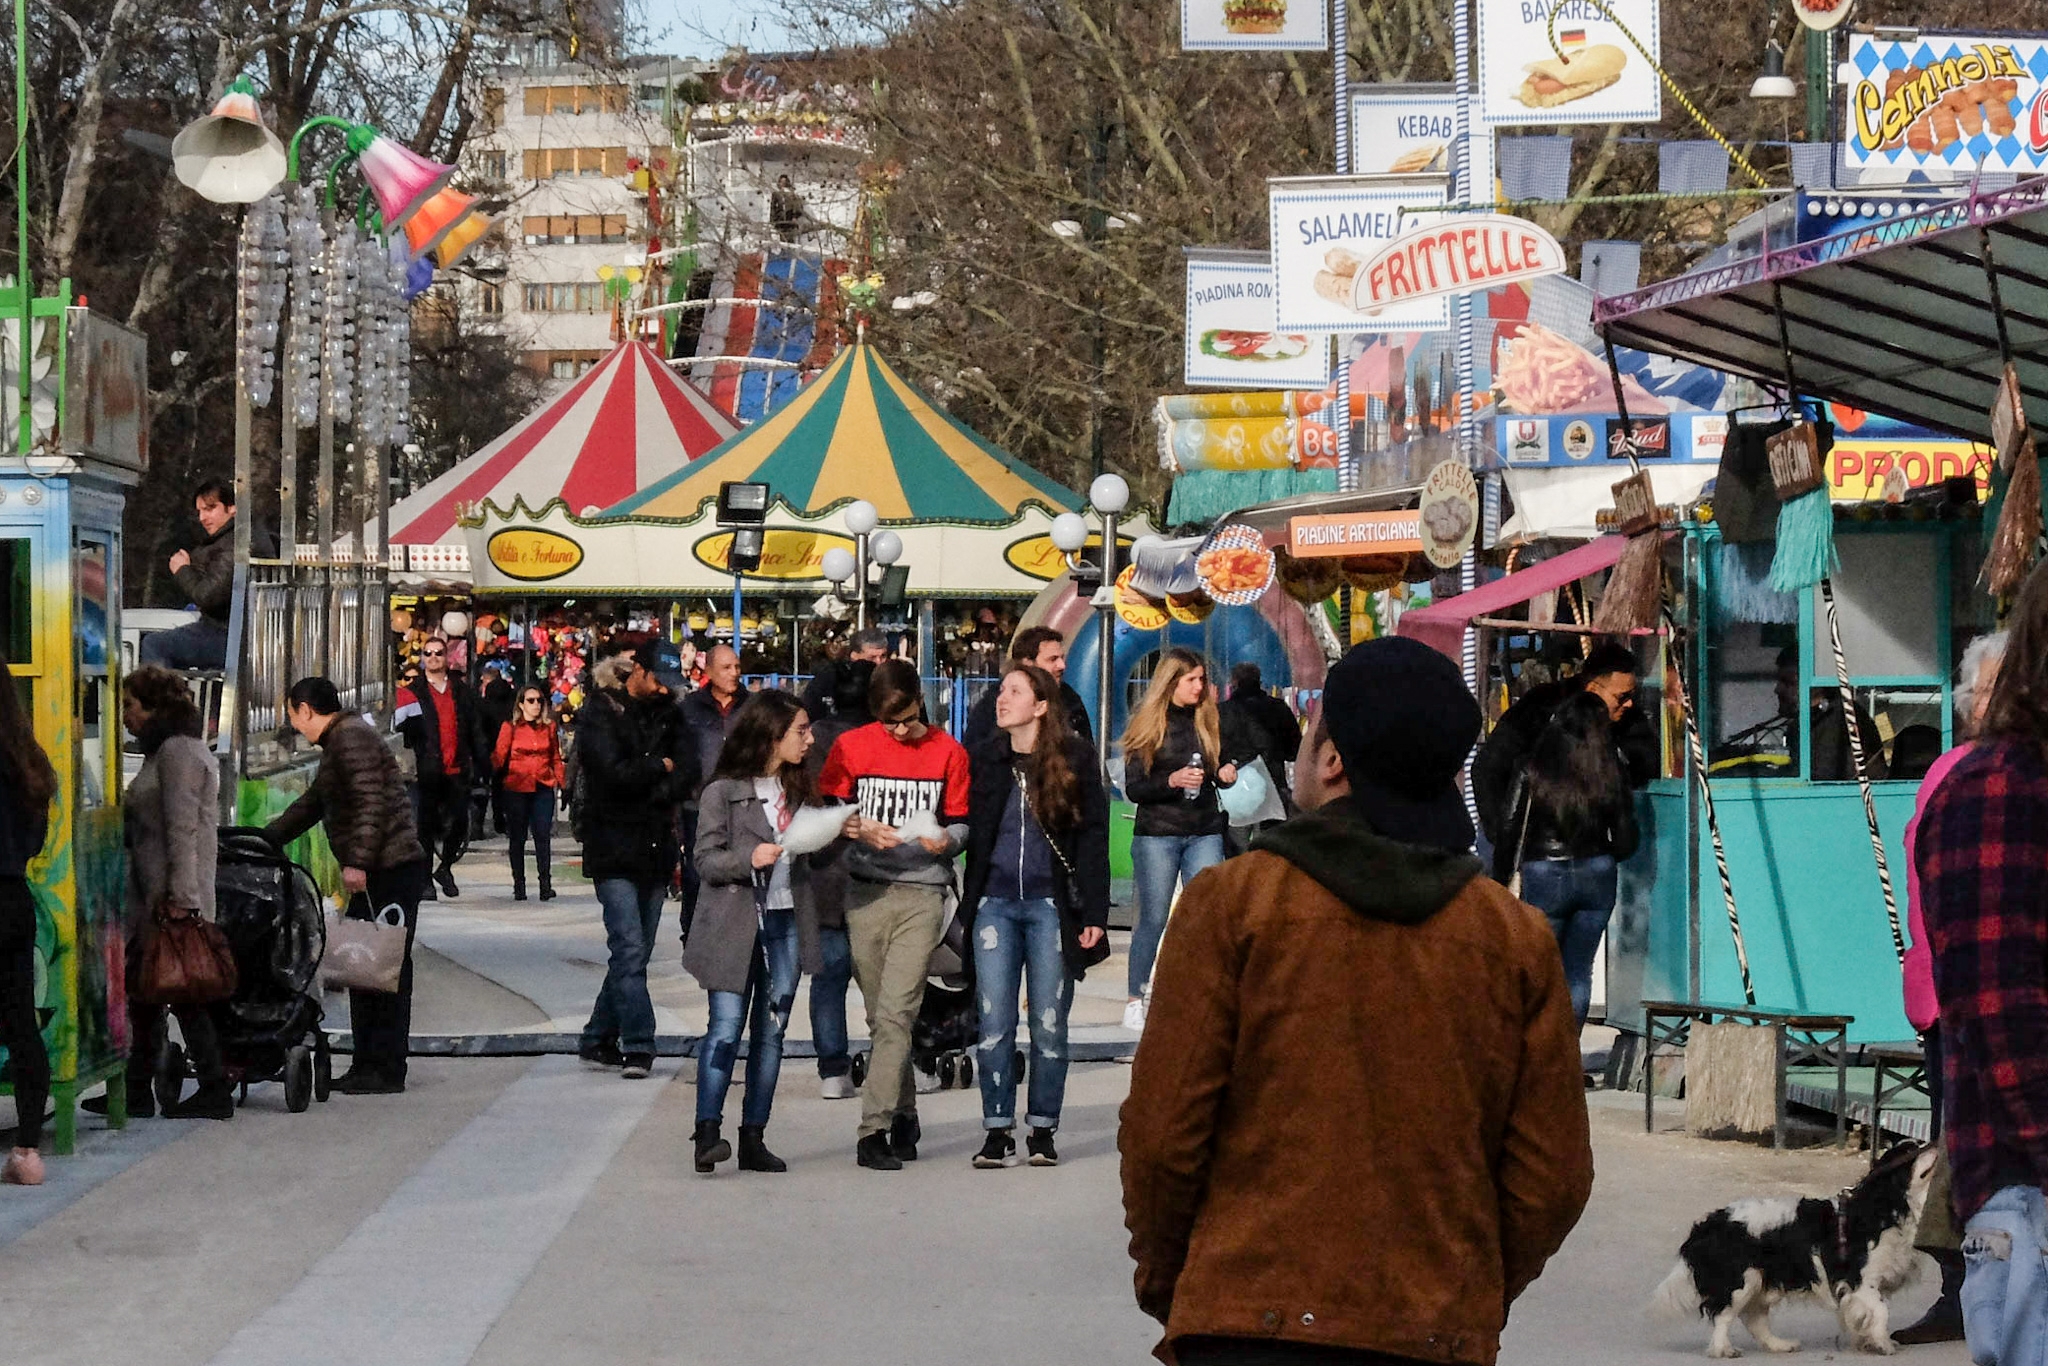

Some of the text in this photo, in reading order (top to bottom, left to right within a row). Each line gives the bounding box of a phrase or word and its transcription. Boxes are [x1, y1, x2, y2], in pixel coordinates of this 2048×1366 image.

[1855, 43, 2031, 151] Cannoli
[1398, 115, 1452, 139] KEBAB
[1369, 228, 1543, 301] FRITTELLE
[1195, 283, 1244, 306] PIADINA
[1427, 463, 1477, 501] FRITTELLE
[1297, 525, 1346, 545] PIADINE
[529, 541, 575, 564] Fortuna
[1430, 547, 1460, 565] nutella
